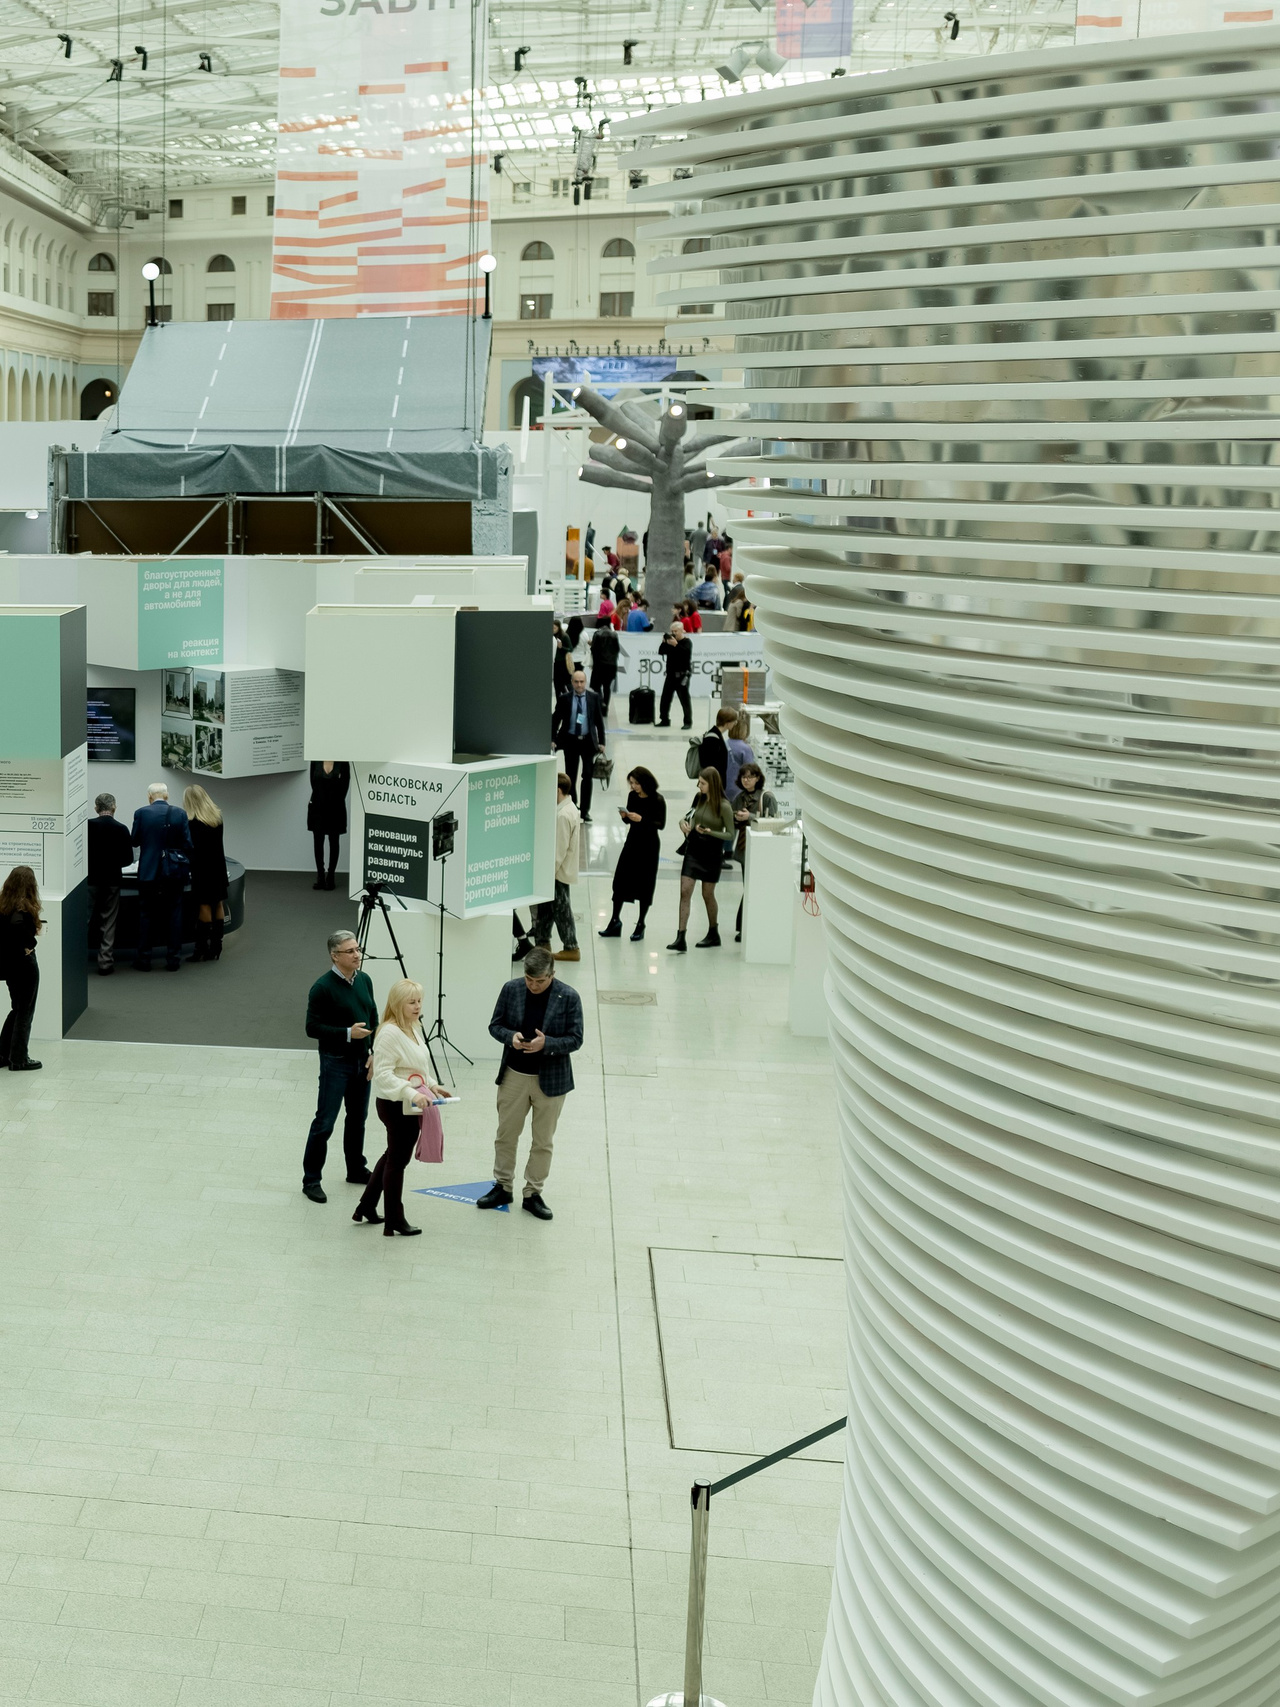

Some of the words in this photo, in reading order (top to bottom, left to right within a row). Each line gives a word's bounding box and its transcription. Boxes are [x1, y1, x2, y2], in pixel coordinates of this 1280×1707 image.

[144, 569, 221, 580] благоустроенные
[143, 582, 171, 591] дворы
[174, 581, 190, 590] для
[192, 577, 222, 587] людей,
[185, 590, 201, 599] для
[144, 598, 201, 610] автомобилей
[183, 638, 219, 649] реакция
[180, 648, 219, 658] контекст
[368, 774, 443, 793] МОСКОВСКАЯ
[485, 774, 521, 789] города,
[368, 790, 417, 806] ОБЛАСТЬ
[485, 793, 491, 802] а
[494, 790, 504, 801] не
[485, 799, 529, 815] спальные
[32, 822, 55, 830] 2022
[484, 814, 520, 832] районы
[368, 828, 417, 843] реновация
[368, 842, 384, 853] как
[385, 845, 423, 859] импульс
[368, 856, 409, 871] развития
[468, 852, 531, 873] качественное
[368, 870, 405, 883] городов
[466, 870, 508, 887] новление
[426, 1189, 477, 1203] РЕГИСТР
